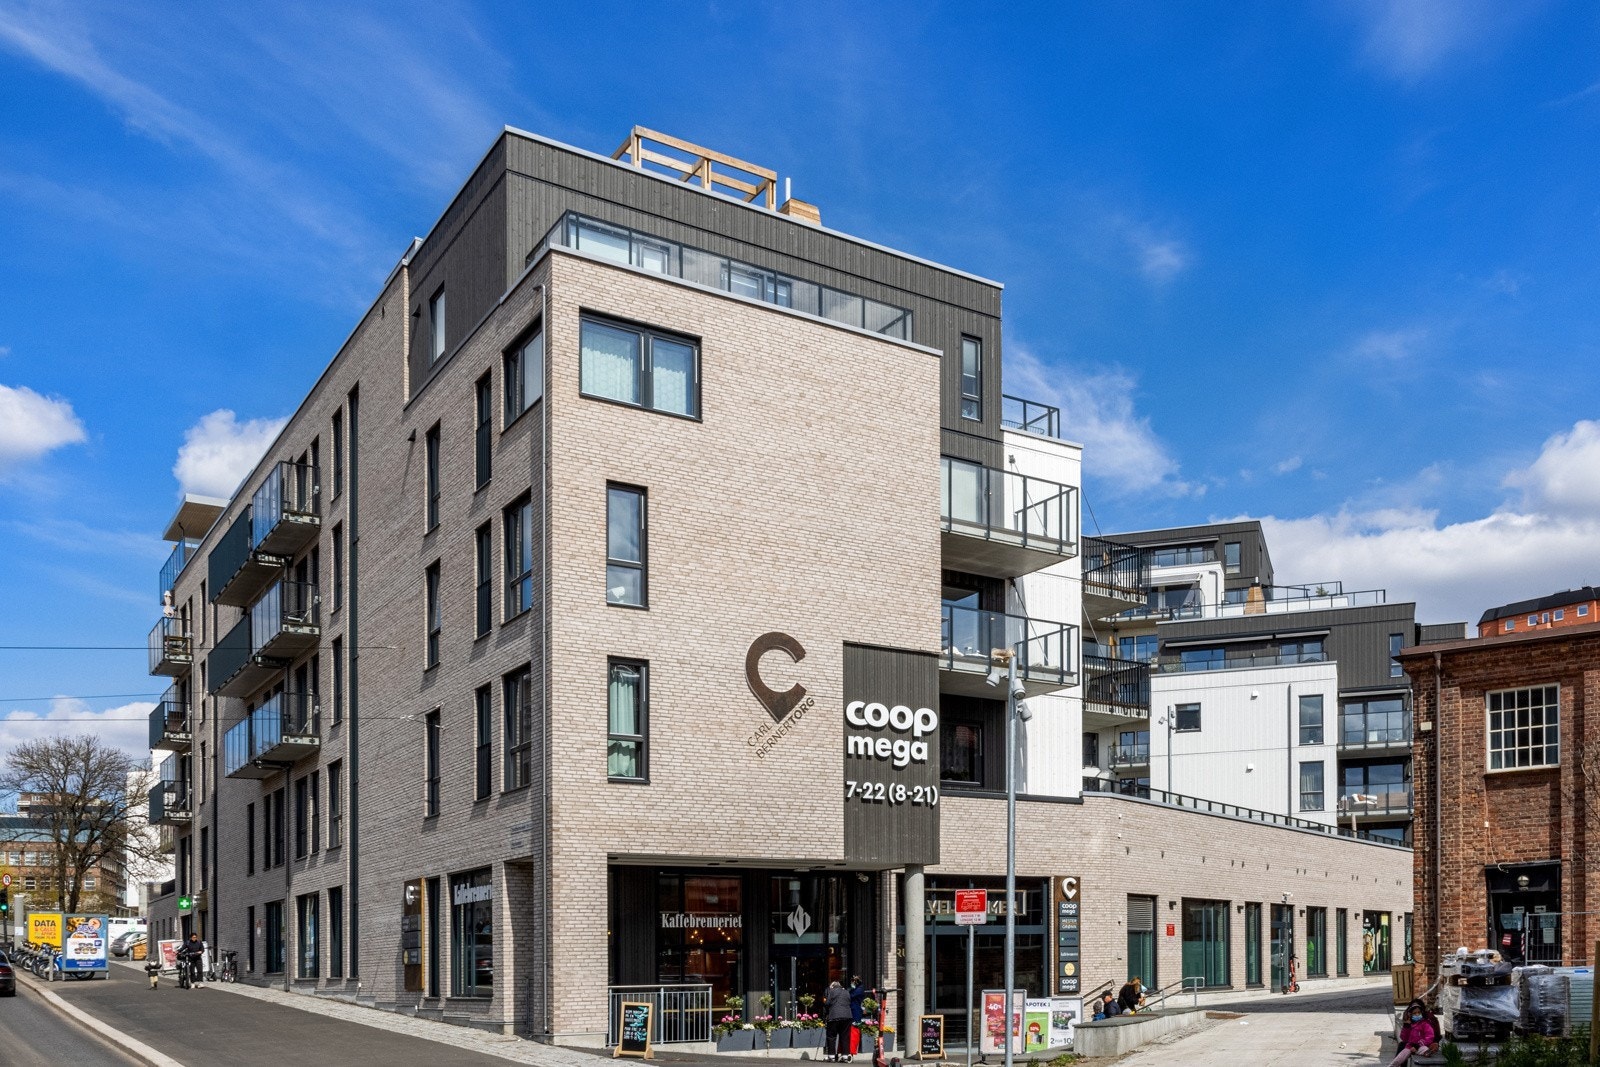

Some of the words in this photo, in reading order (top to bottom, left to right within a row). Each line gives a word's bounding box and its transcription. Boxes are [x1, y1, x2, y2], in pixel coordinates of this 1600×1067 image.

[755, 697, 815, 759] BERNERTORG
[845, 700, 938, 737] coop
[747, 722, 773, 747] CARL
[847, 735, 928, 767] mega
[845, 780, 886, 800] 7-22
[888, 782, 938, 806] (8-21)
[34, 919, 56, 927] DATA
[661, 913, 743, 928] Kaffebrenneriet
